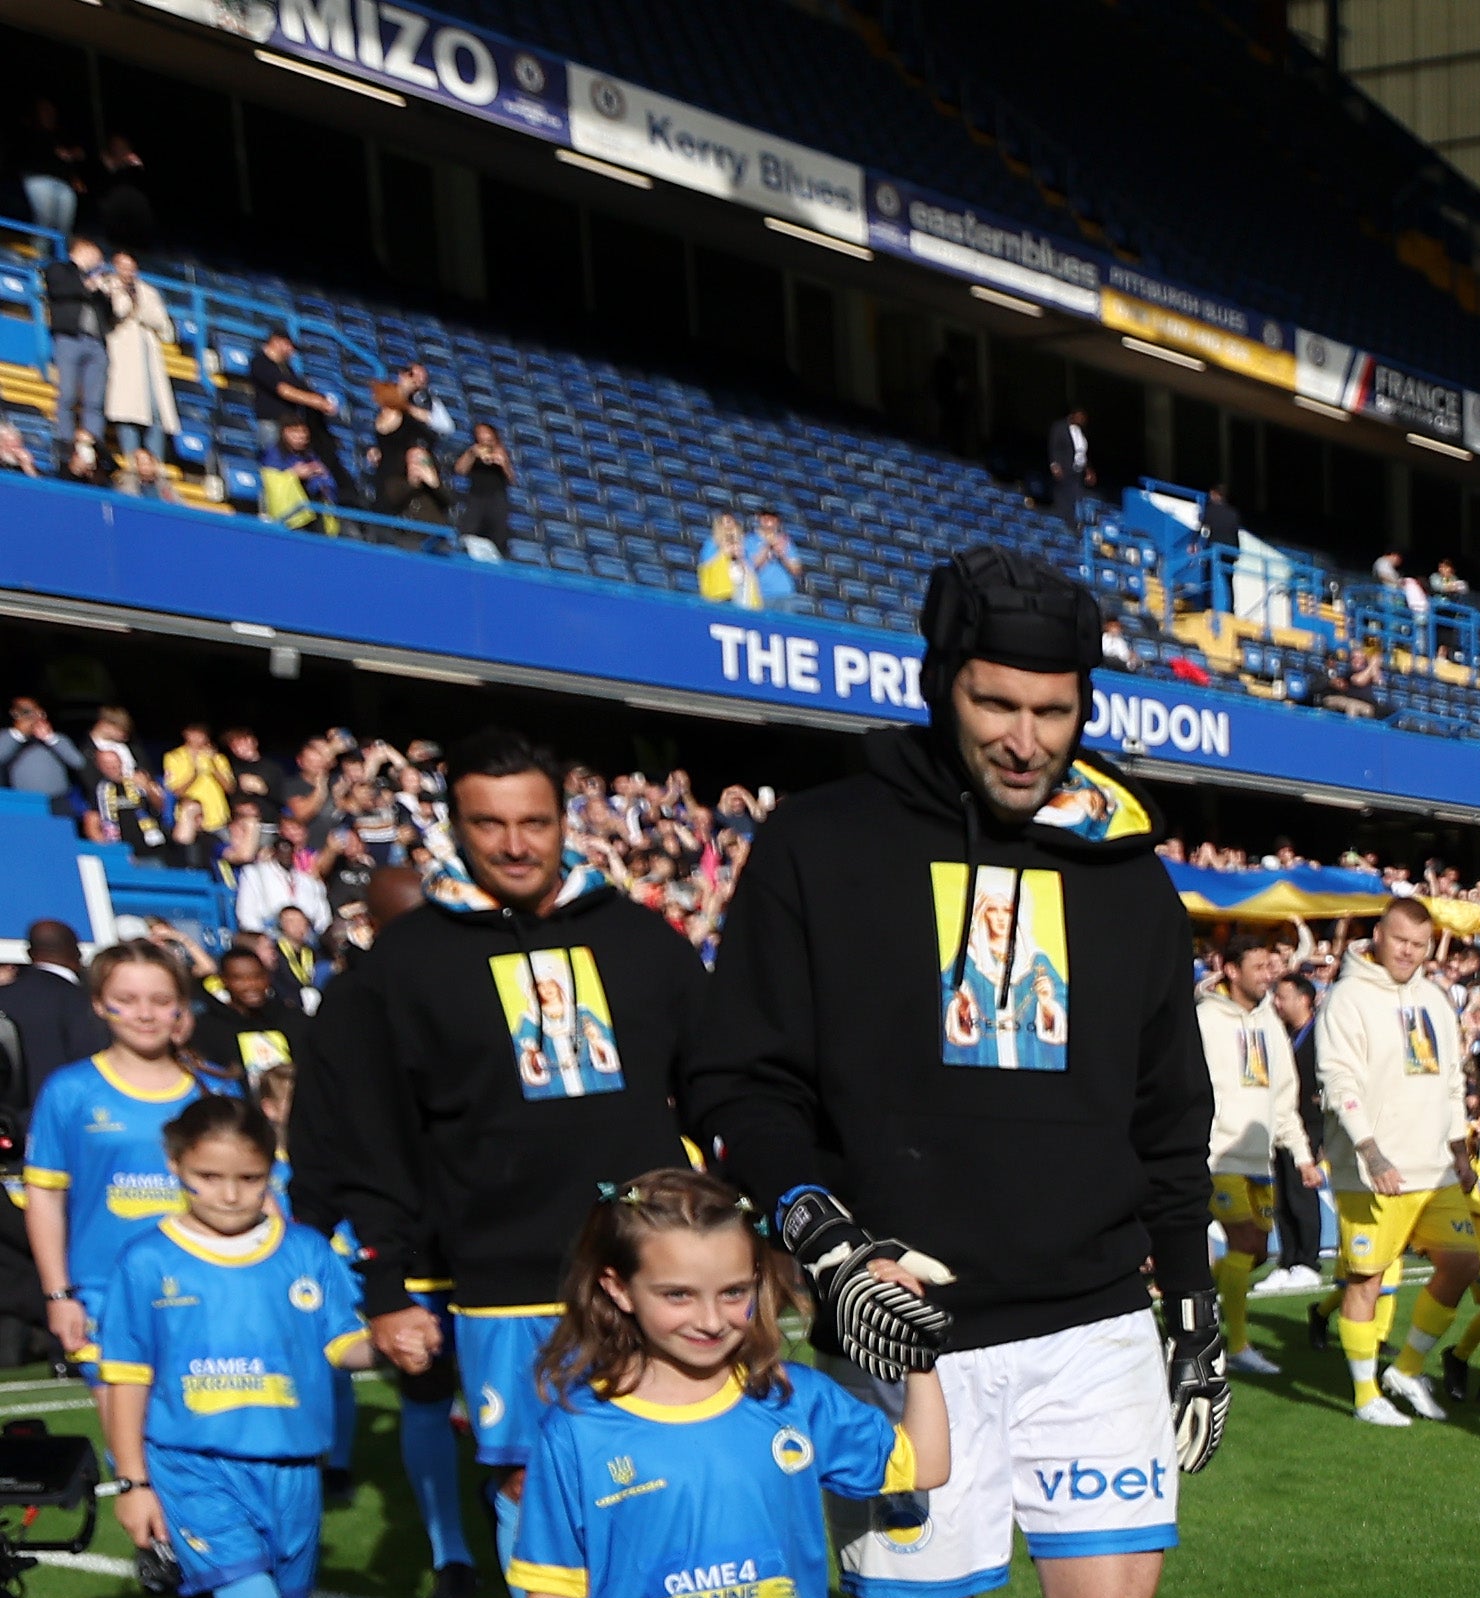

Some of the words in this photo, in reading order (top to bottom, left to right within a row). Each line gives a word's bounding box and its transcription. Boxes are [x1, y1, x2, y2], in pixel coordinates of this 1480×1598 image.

[645, 108, 747, 189] Kerry
[759, 150, 858, 213] Blues
[1375, 364, 1461, 416] FRANCE
[709, 624, 821, 694] THE
[833, 645, 926, 709] PRI
[1084, 688, 1230, 757] ONDON
[188, 1357, 266, 1376] GAME4
[1034, 1457, 1166, 1501] vbet
